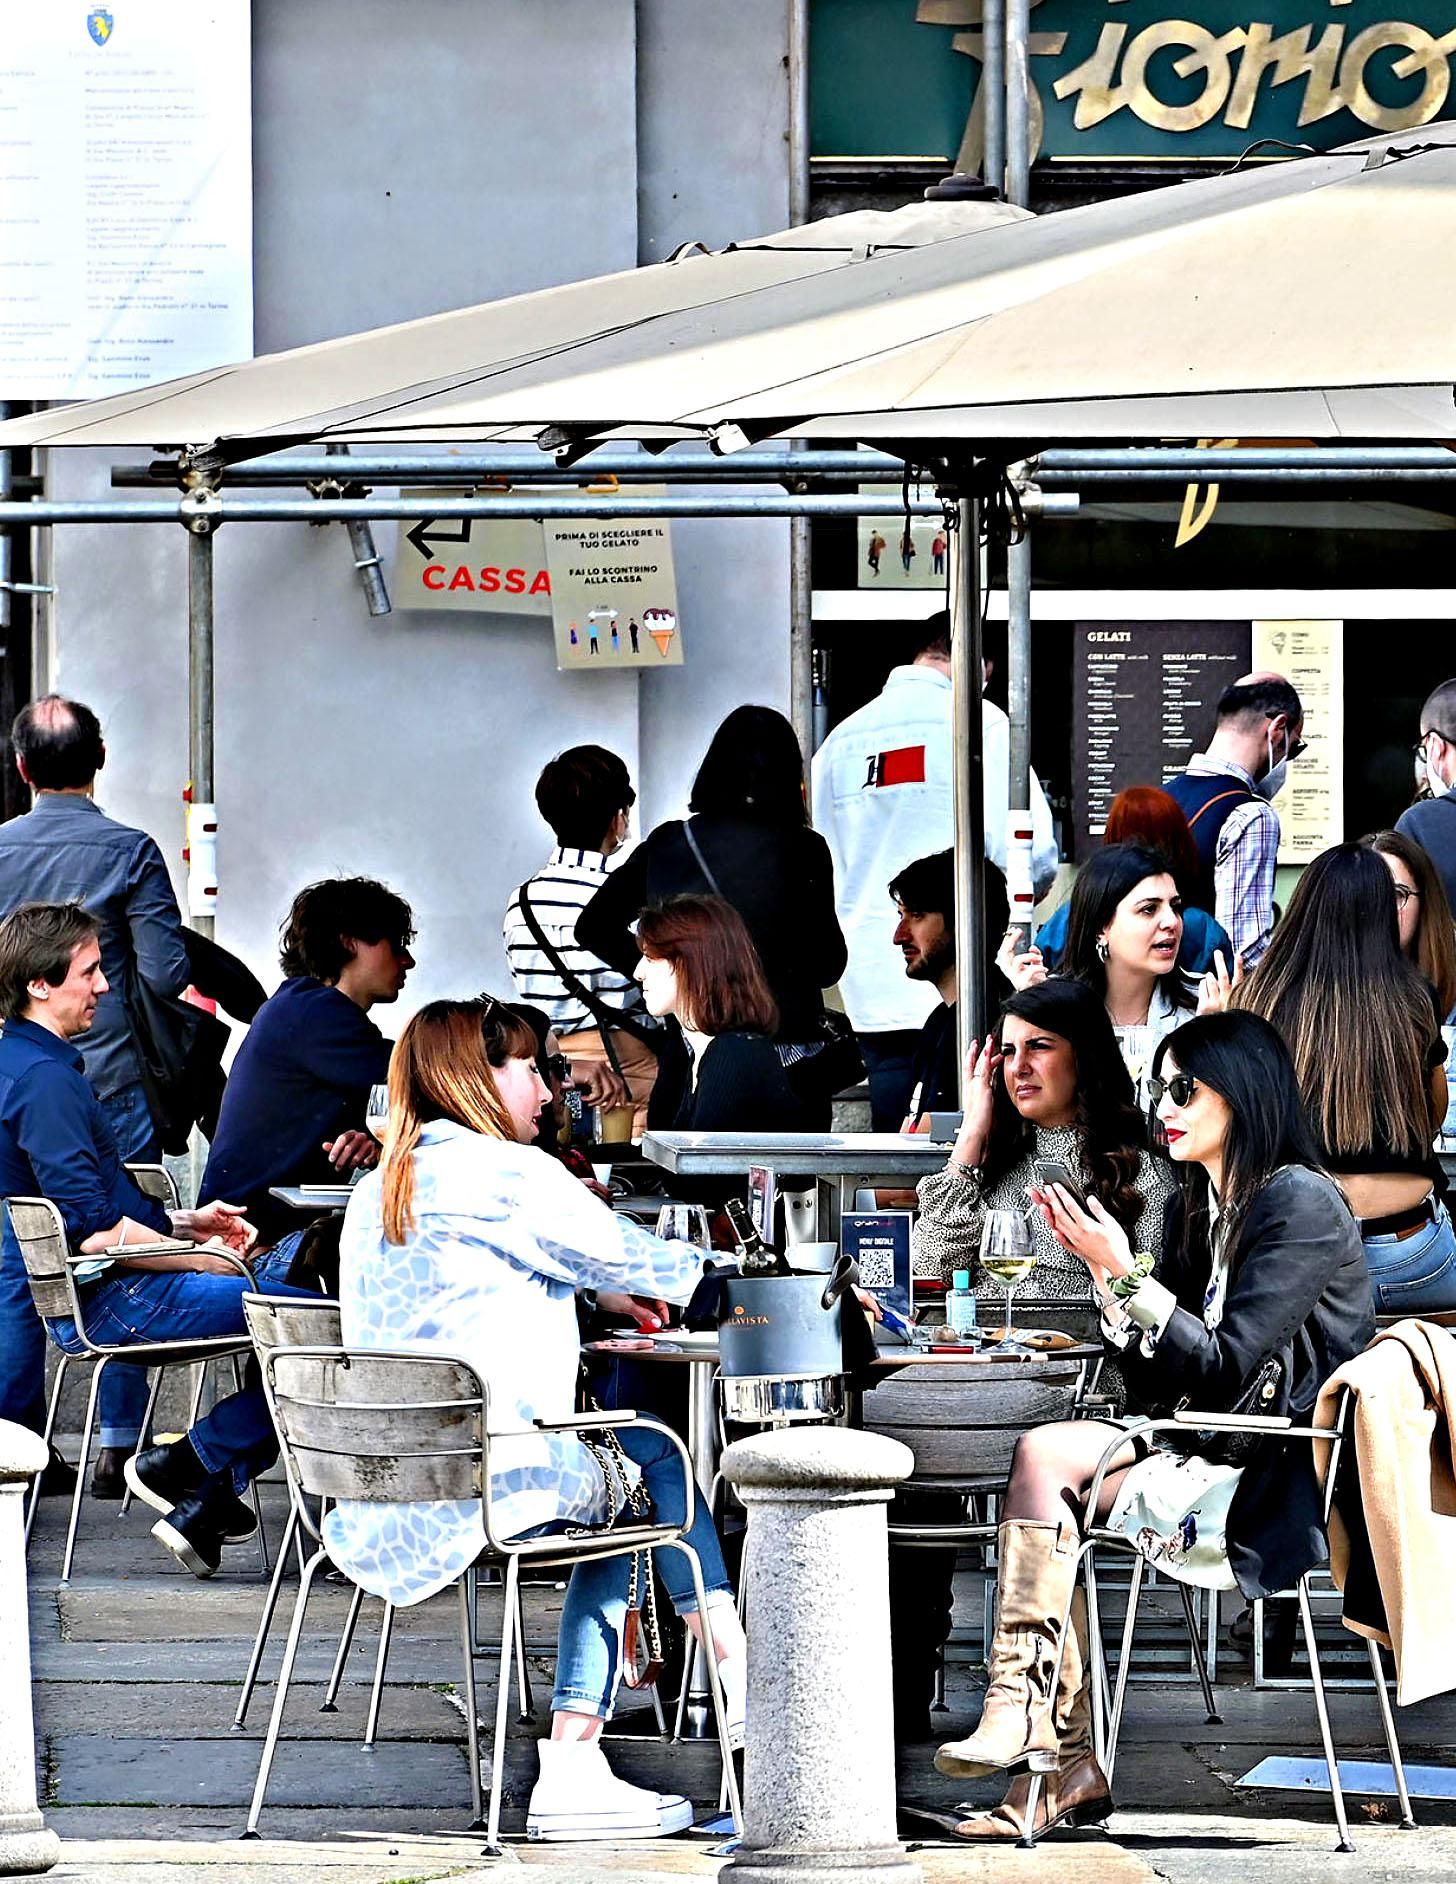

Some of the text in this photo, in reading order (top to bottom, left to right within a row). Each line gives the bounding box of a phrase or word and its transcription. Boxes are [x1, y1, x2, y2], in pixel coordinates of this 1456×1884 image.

[555, 529, 664, 541] PRIMA DI SCEGLIERE IL
[580, 539, 639, 549] TUO GELATO
[569, 565, 658, 576] FAI LO SCONTRINO
[422, 565, 552, 596] CASSA
[584, 575, 642, 585] ALLA CASSA
[1087, 631, 1131, 642] GELATI
